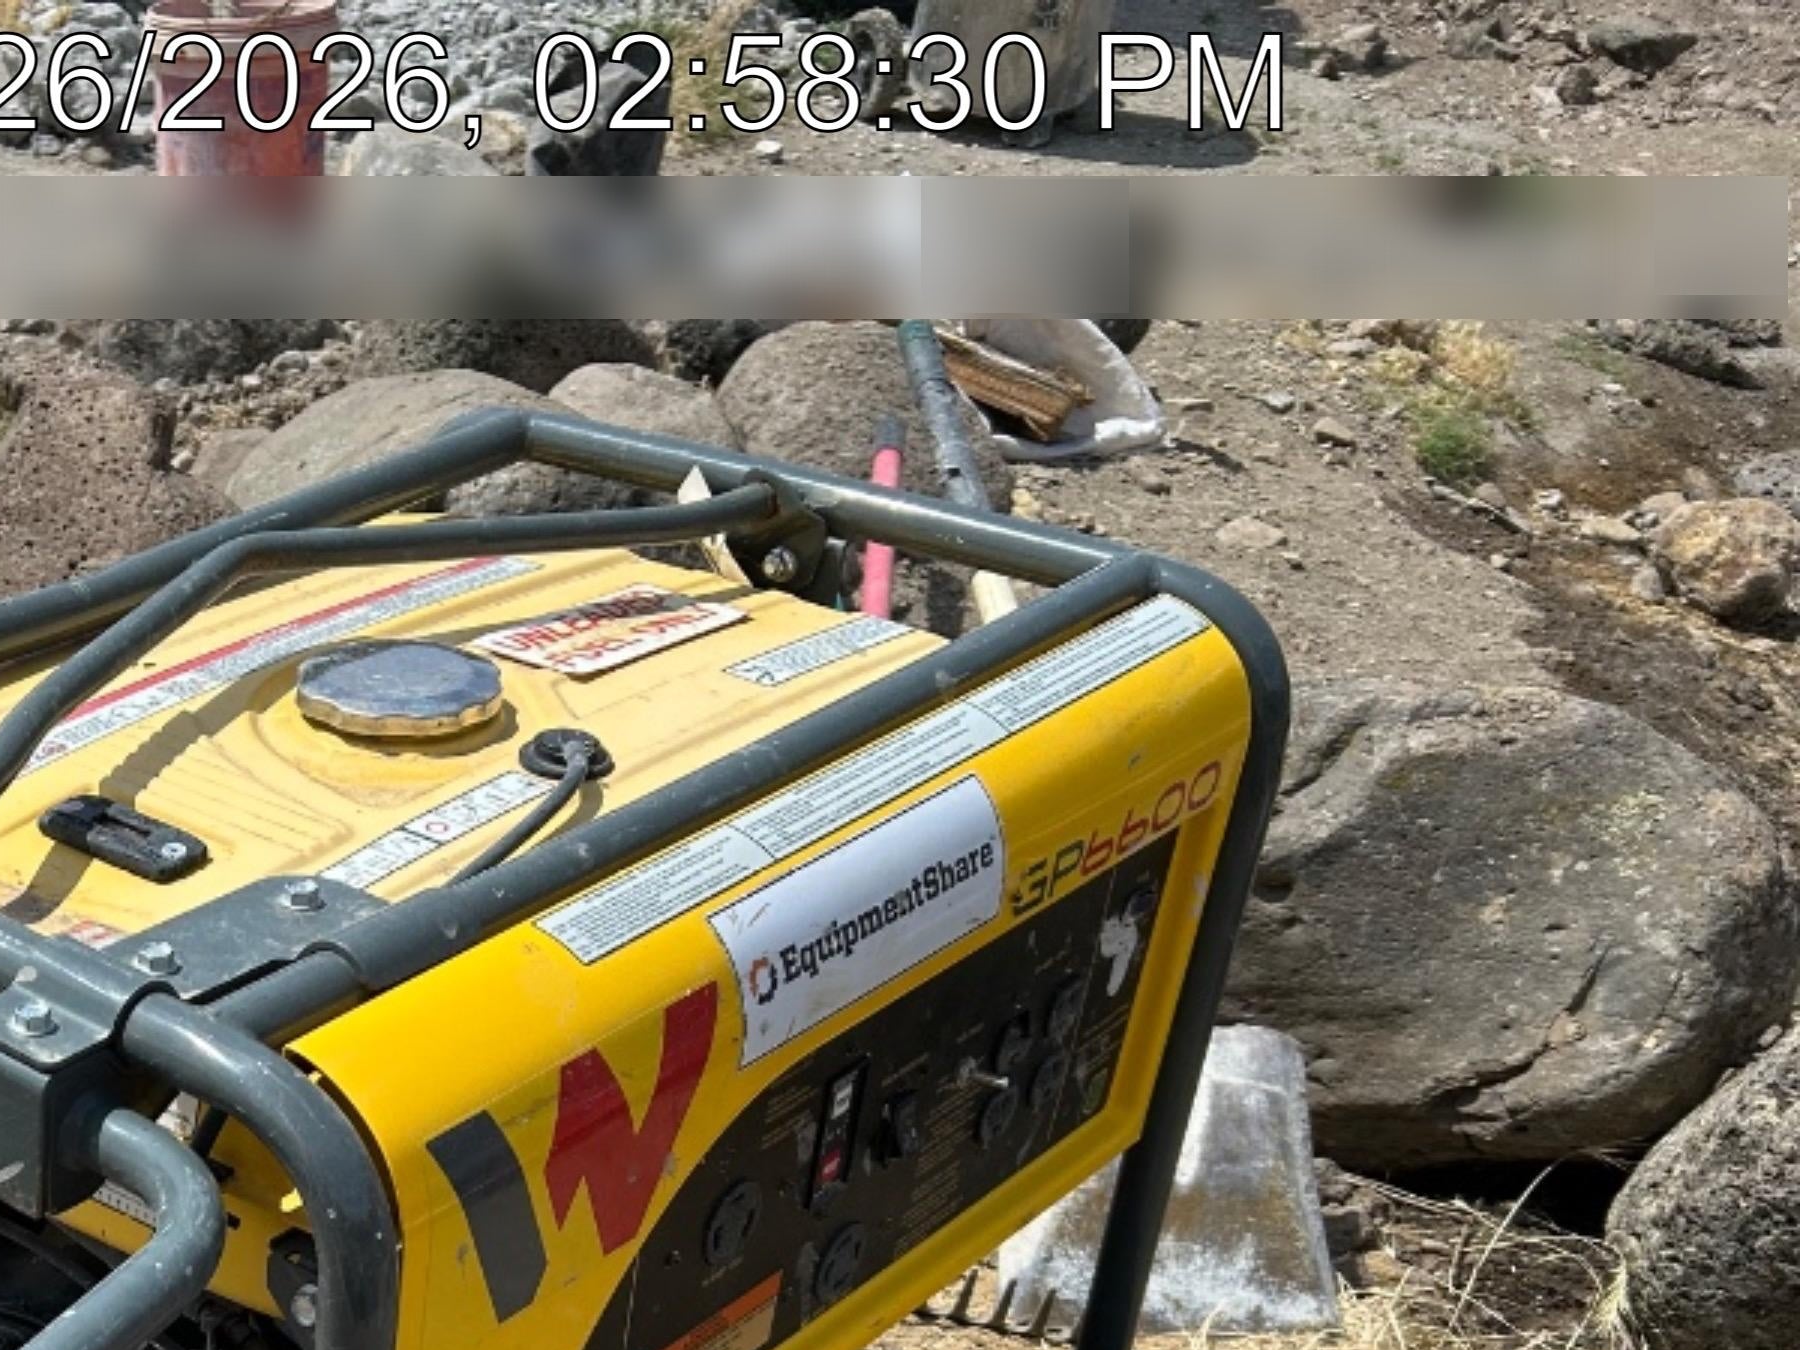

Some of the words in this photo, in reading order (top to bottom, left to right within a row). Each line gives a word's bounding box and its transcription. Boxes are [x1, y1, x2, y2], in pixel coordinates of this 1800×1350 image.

[493, 590, 665, 651] UNLEADED
[1013, 760, 1222, 916] GP6600
[779, 841, 994, 984] EquipmentShare
